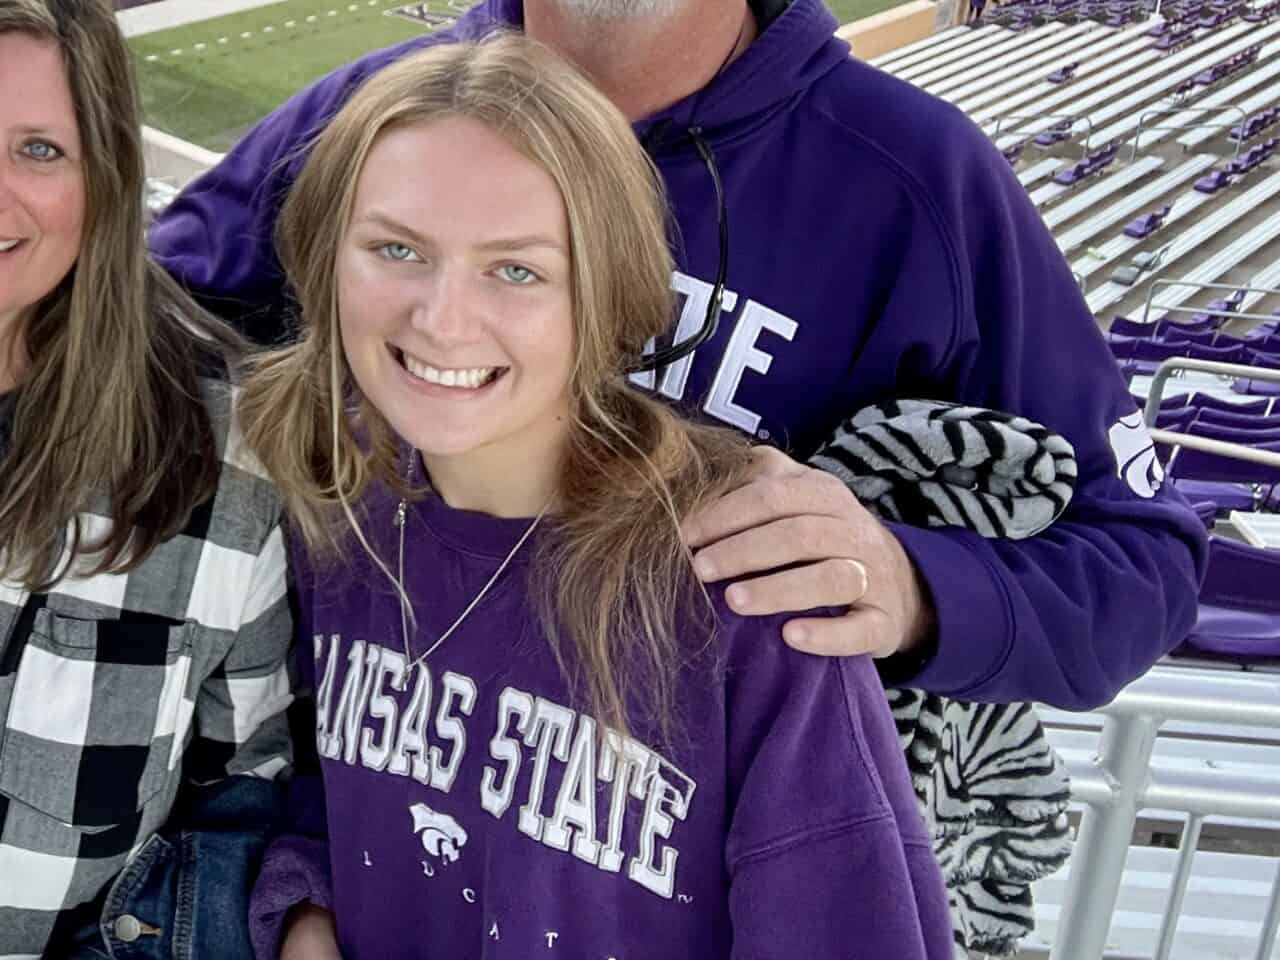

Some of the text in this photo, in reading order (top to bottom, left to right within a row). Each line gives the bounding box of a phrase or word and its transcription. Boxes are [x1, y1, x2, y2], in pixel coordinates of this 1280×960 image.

[628, 270, 799, 435] TE
[314, 634, 697, 899] ANSAS STATE
